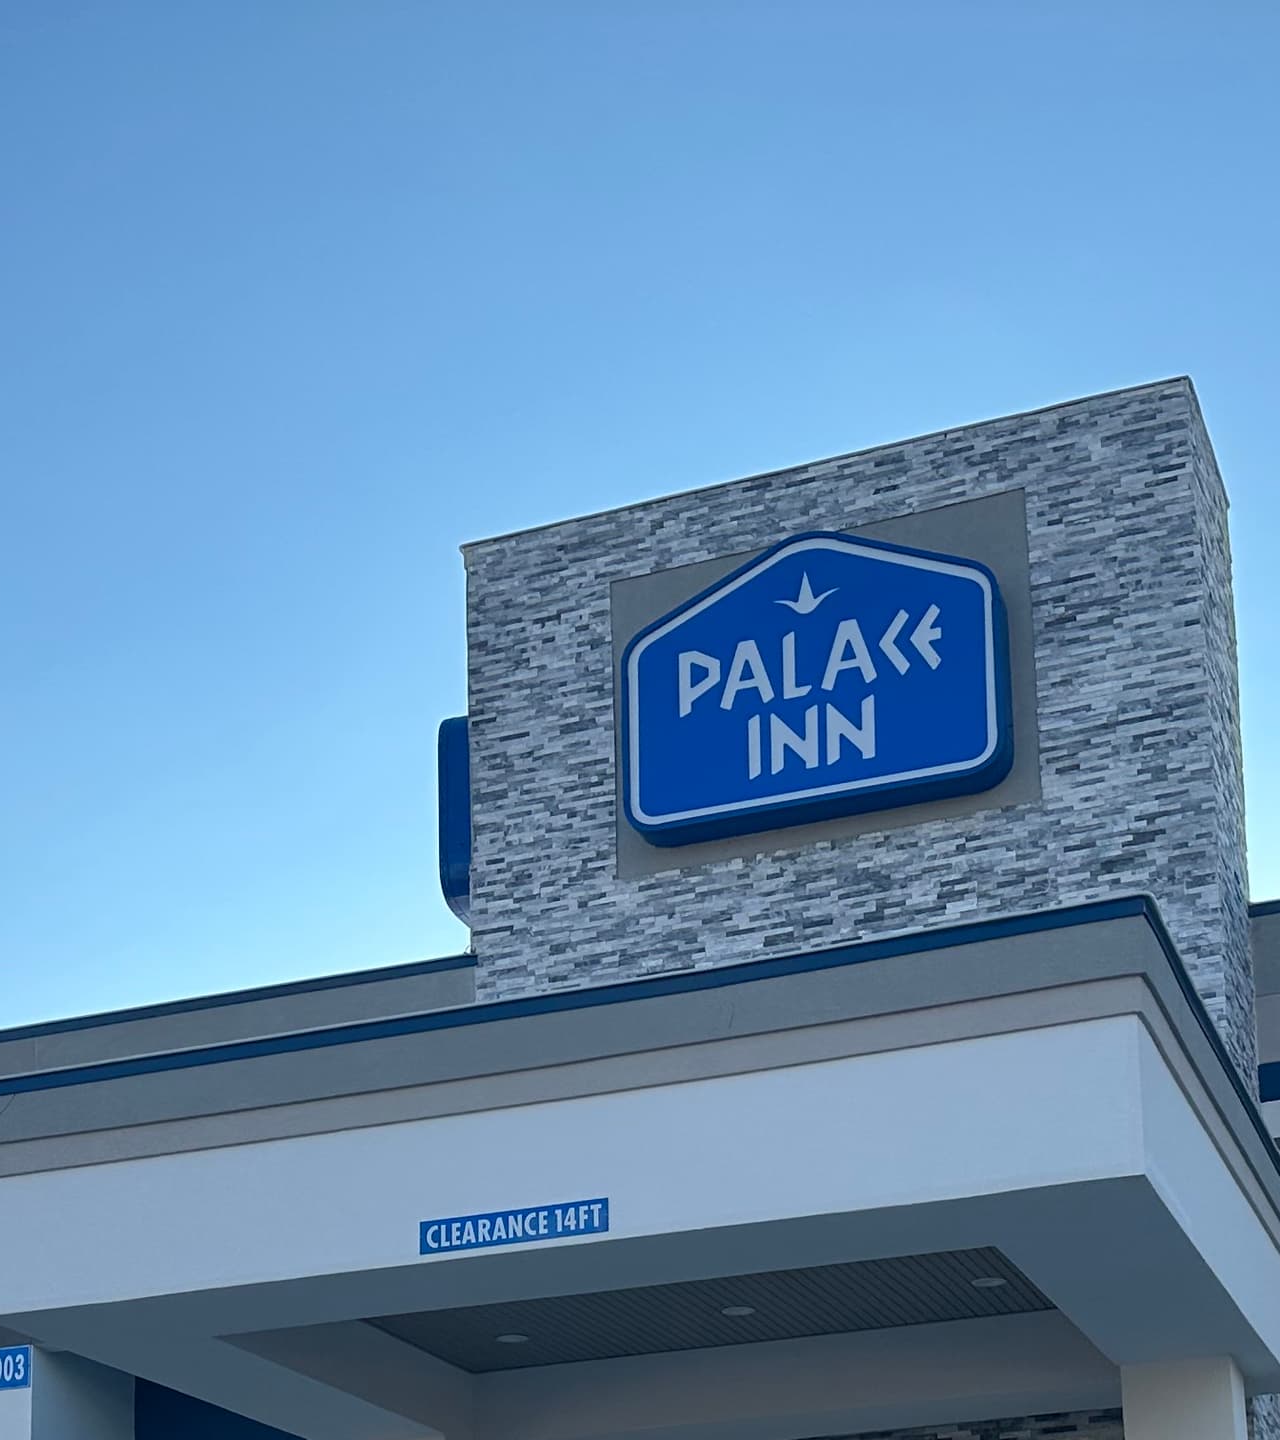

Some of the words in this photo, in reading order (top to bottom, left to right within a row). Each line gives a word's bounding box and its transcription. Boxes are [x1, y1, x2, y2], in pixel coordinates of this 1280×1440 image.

[678, 604, 942, 718] PALACE
[748, 694, 876, 780] INN
[426, 1210, 549, 1249] CLEARANCE
[555, 1204, 602, 1233] 14FT
